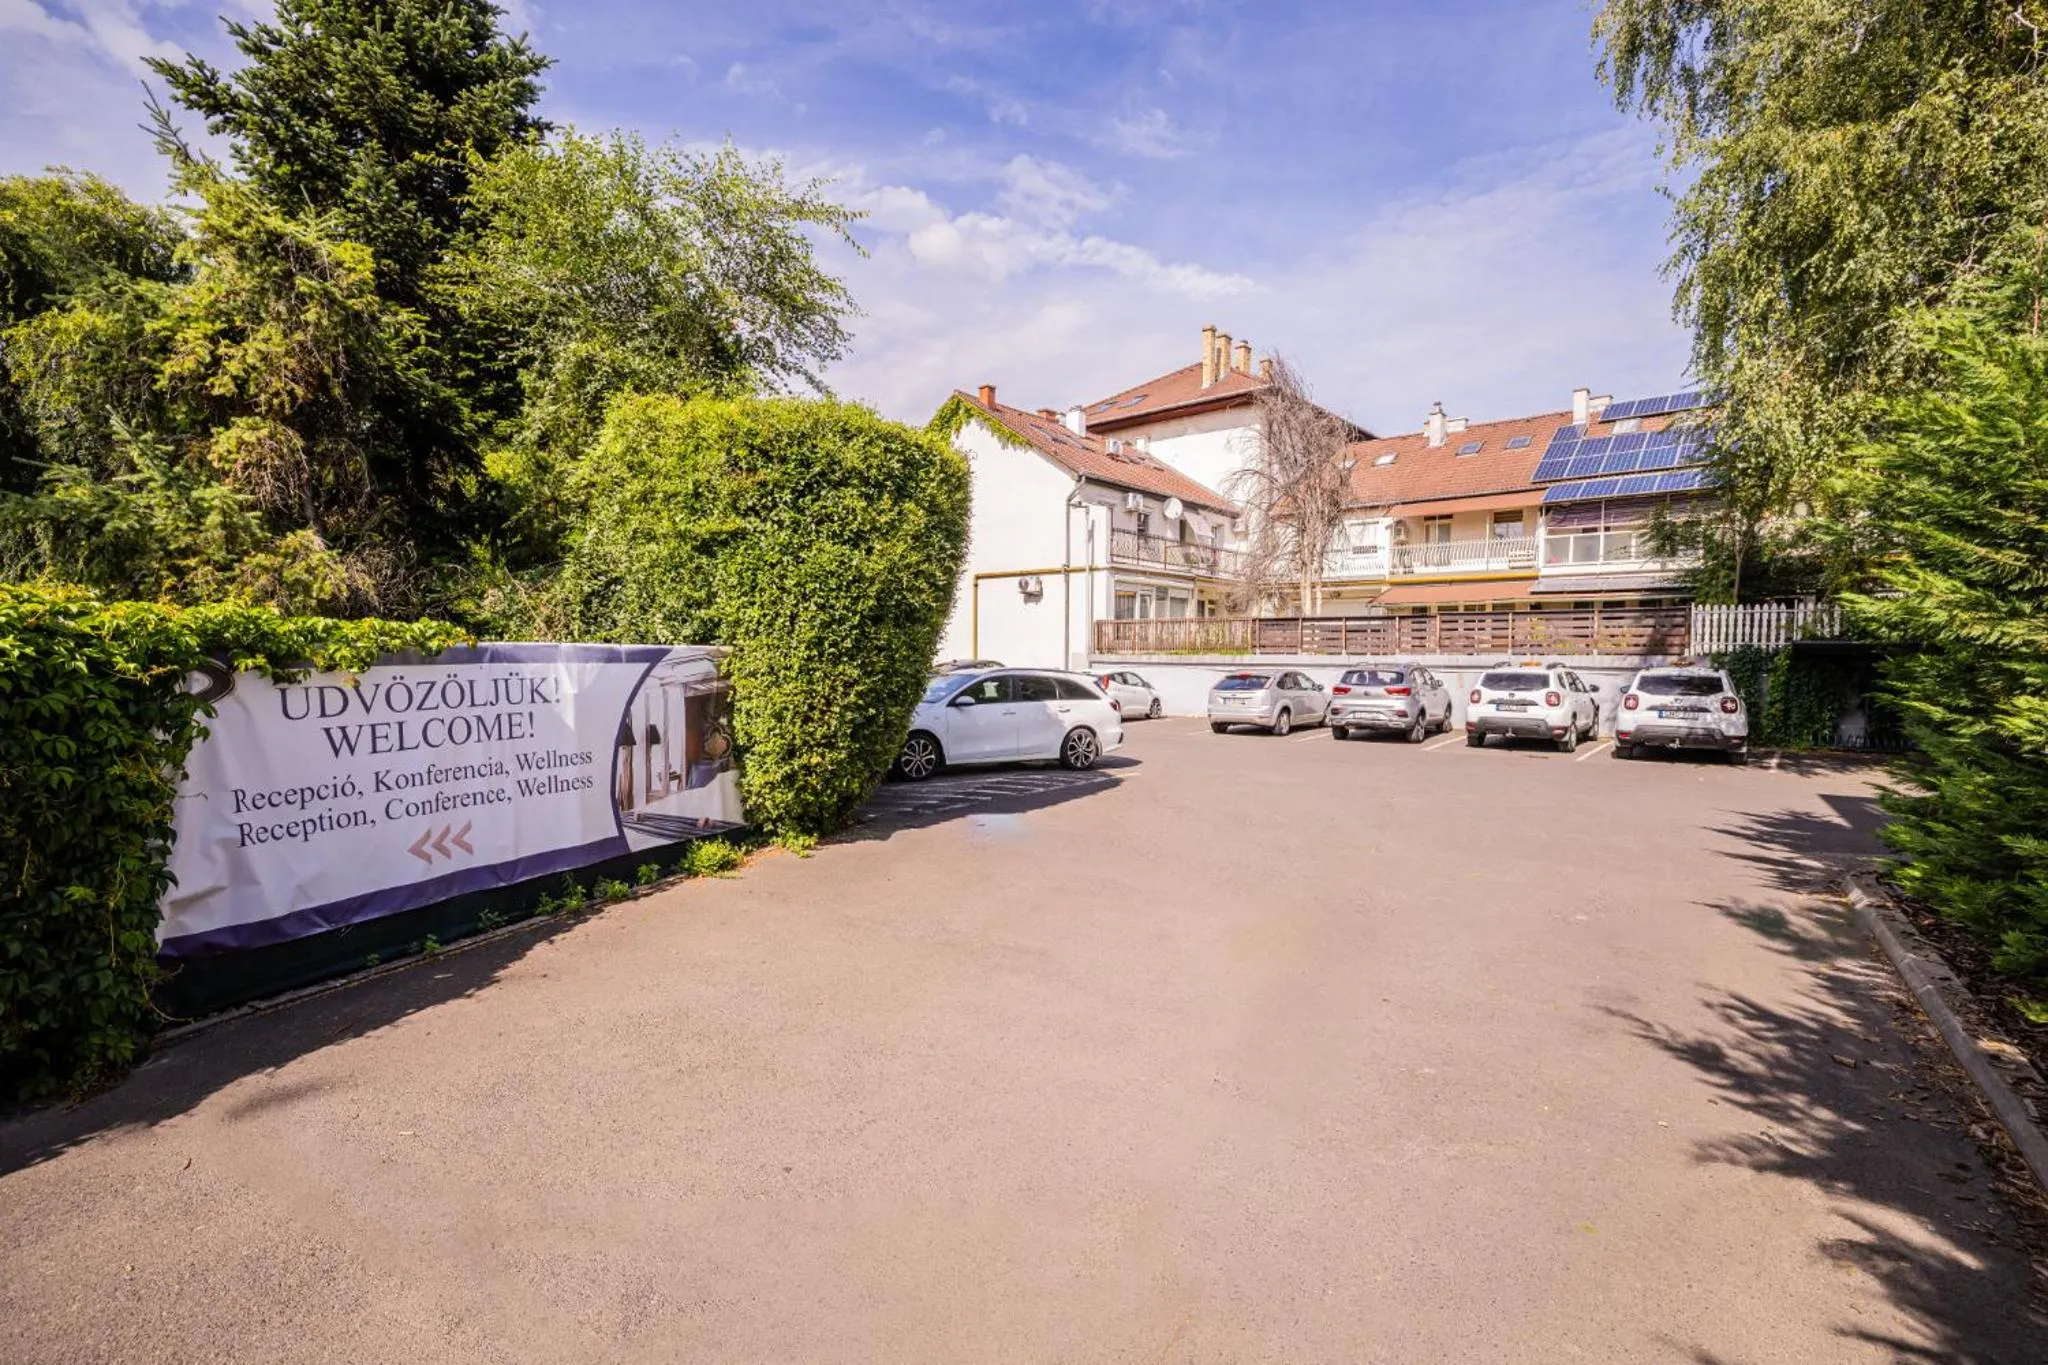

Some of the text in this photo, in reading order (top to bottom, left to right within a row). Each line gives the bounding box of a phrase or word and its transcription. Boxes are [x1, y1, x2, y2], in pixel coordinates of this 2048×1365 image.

[321, 711, 534, 759] WELCOME!
[231, 750, 593, 814] Recepció, Konferencia, Wellness
[236, 775, 594, 848] Reception, Conference, Wellness
